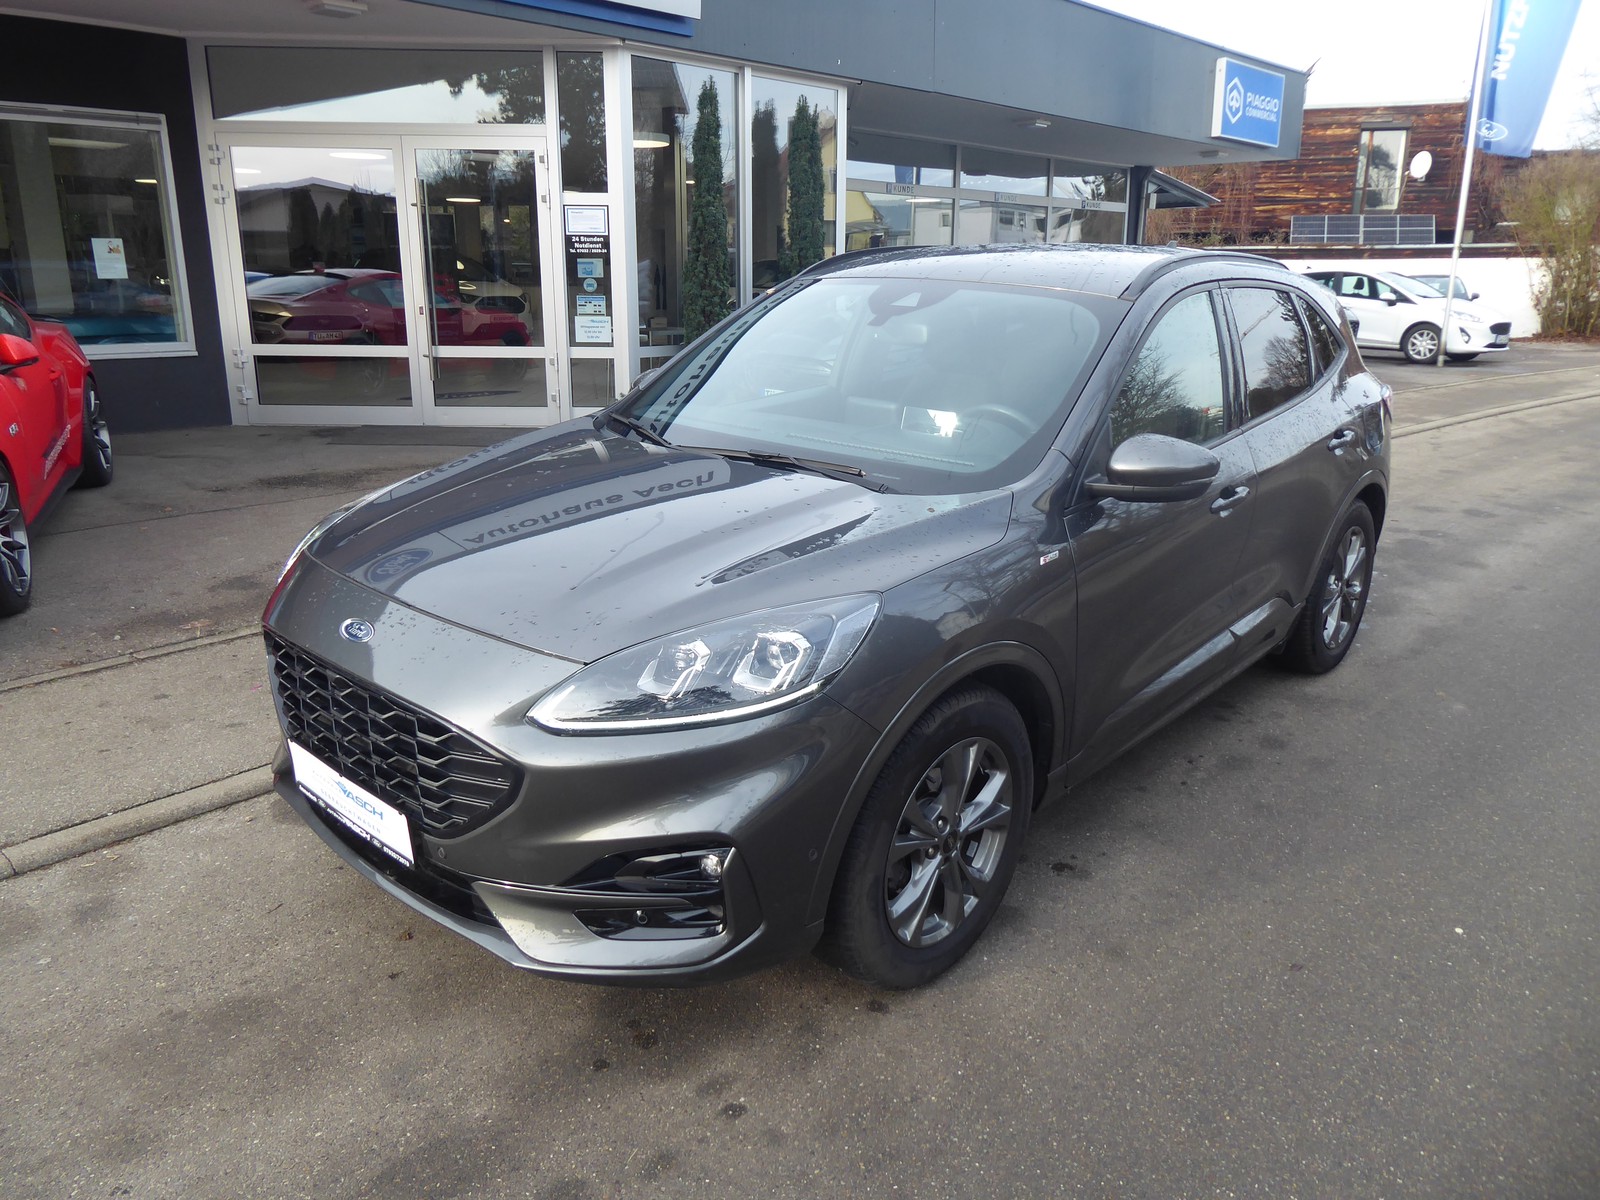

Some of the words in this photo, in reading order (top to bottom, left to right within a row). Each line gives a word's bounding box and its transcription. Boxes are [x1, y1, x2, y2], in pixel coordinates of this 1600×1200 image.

[1246, 92, 1279, 112] PIAGGIO
[893, 184, 914, 194] KUNDE
[346, 791, 384, 821] ASCH
